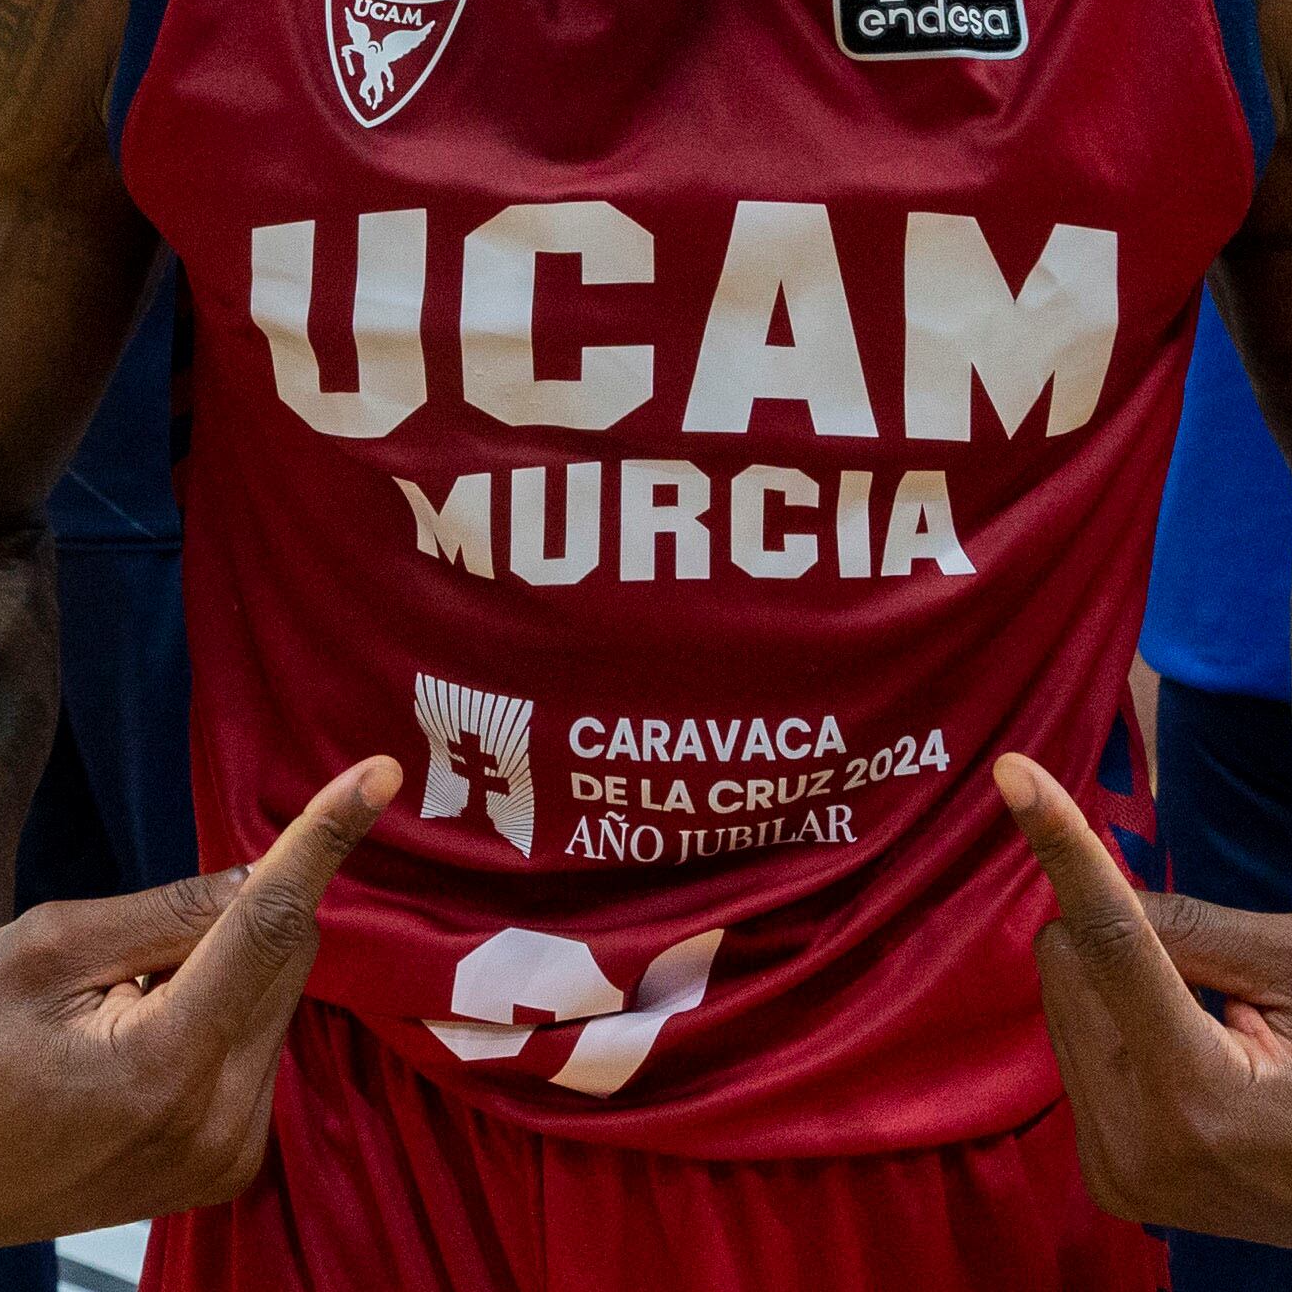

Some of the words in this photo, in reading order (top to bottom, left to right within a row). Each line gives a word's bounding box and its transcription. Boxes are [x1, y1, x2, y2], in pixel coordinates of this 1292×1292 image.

[251, 200, 1119, 442] UCAM
[392, 458, 977, 585] MURCIA
[568, 714, 847, 762] CARAVACA
[571, 771, 628, 806] DE
[640, 778, 696, 815] LA
[708, 770, 835, 815] CRUZ
[843, 729, 951, 792] 2024
[565, 811, 665, 863] AÑO
[674, 804, 859, 866] JUBILAR
